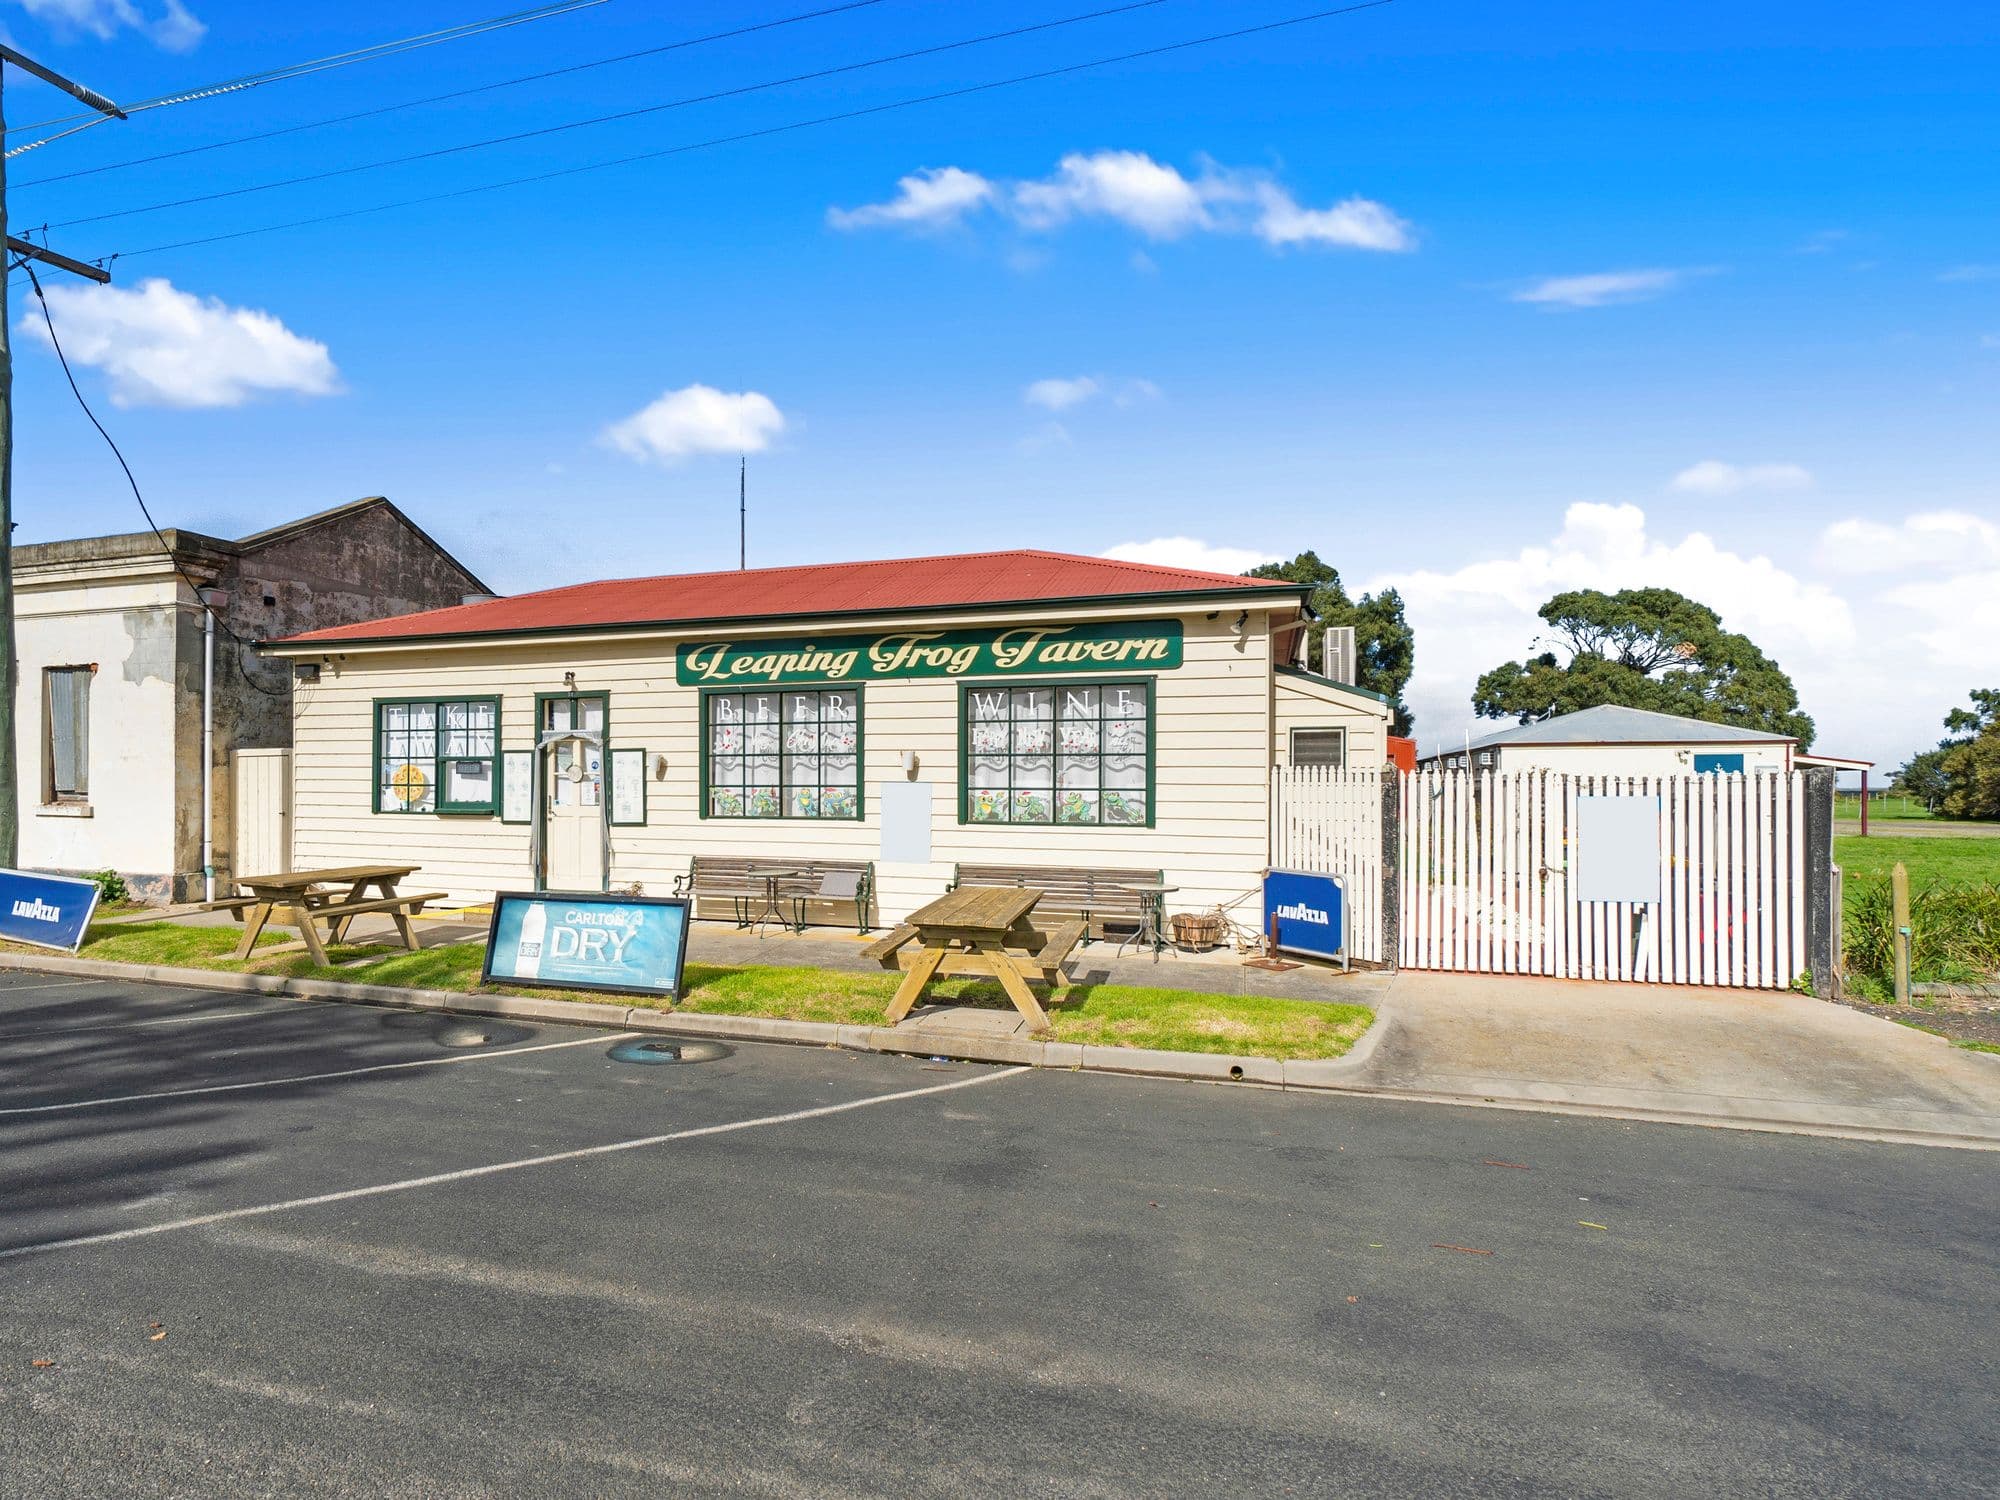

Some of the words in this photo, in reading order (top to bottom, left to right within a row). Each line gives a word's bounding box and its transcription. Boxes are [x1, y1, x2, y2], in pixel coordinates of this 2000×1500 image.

[685, 643, 859, 681] Leaping
[868, 632, 980, 674] Frog
[991, 626, 1169, 668] Tavern
[719, 695, 848, 721] BEER
[972, 689, 1131, 716] WINE
[565, 910, 625, 927] CARLTON
[550, 925, 637, 963] DRY
